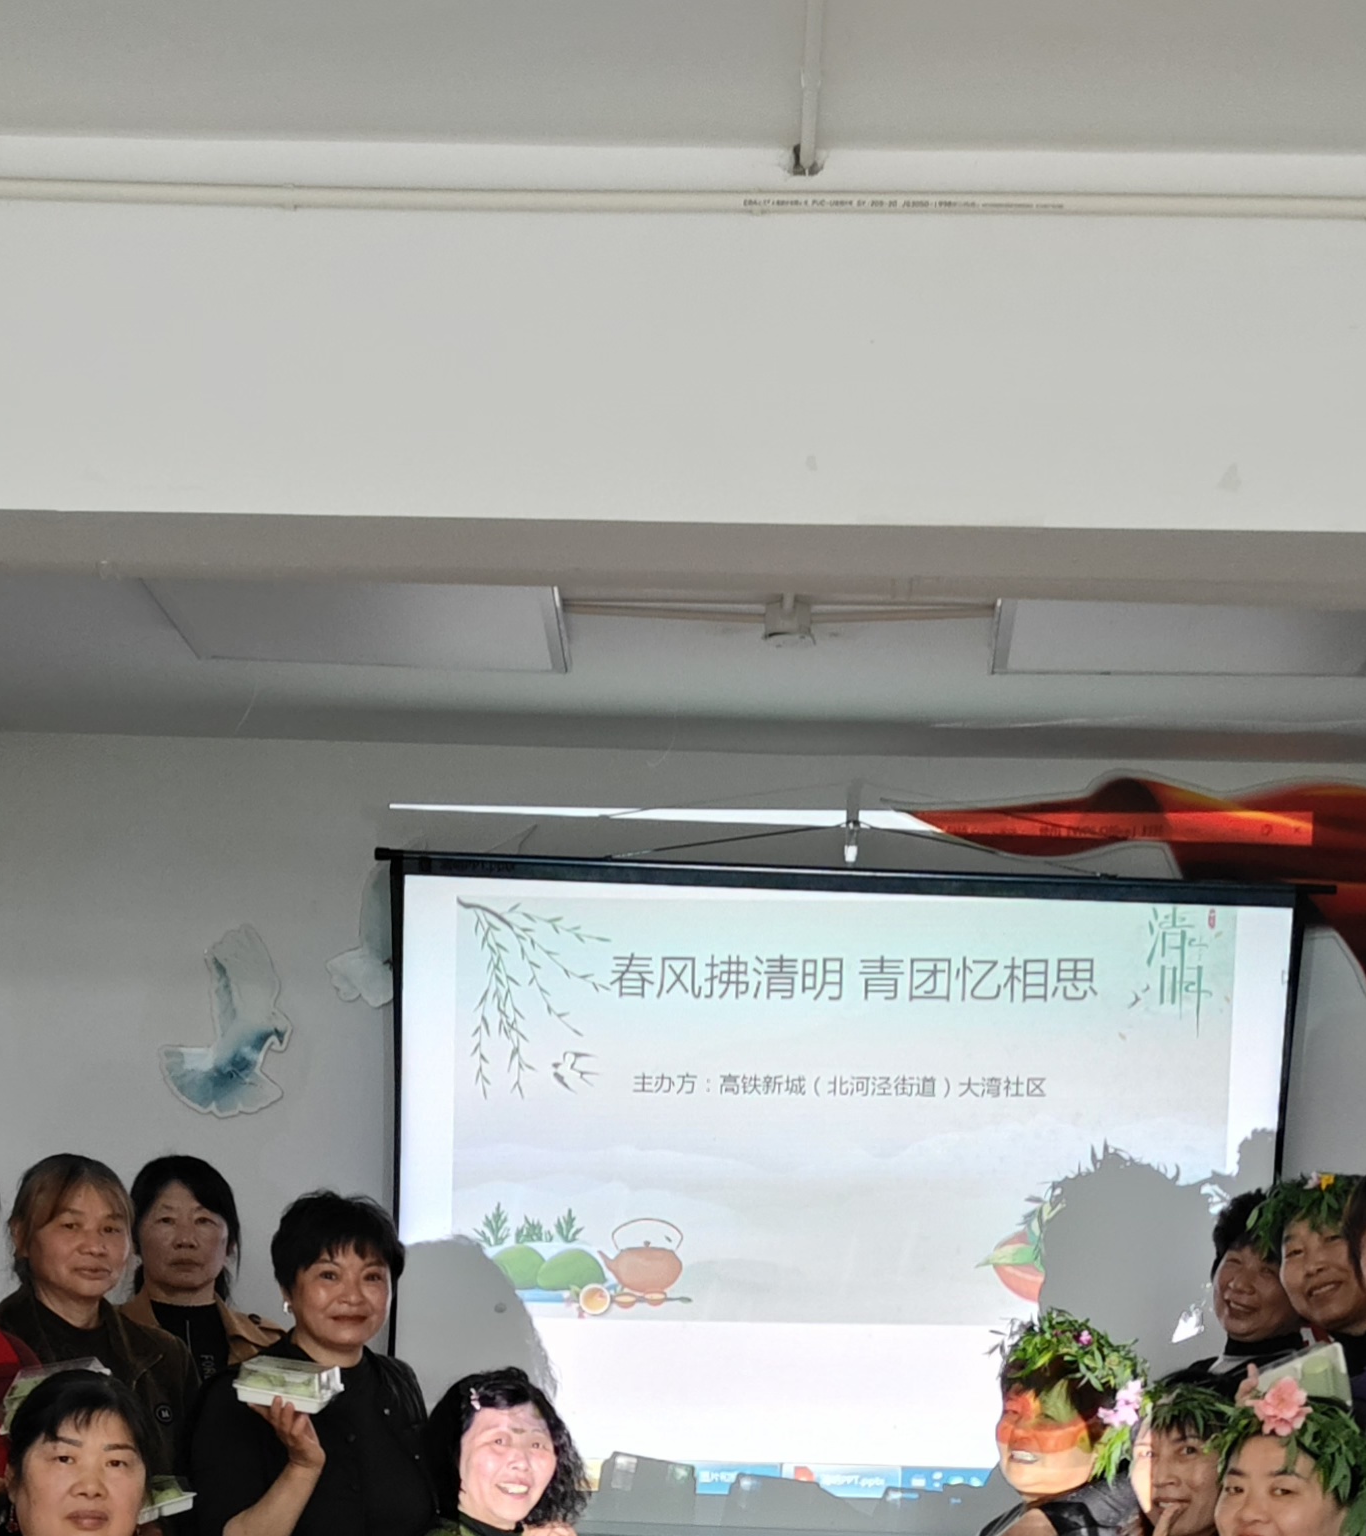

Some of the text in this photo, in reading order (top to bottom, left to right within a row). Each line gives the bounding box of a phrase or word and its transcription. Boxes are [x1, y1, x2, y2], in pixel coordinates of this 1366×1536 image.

[609, 952, 1098, 1002] 春风拂清明 青团忆相思
[632, 1072, 1047, 1099] 主办方：高铁新城（北河泾街道）大湾社区
